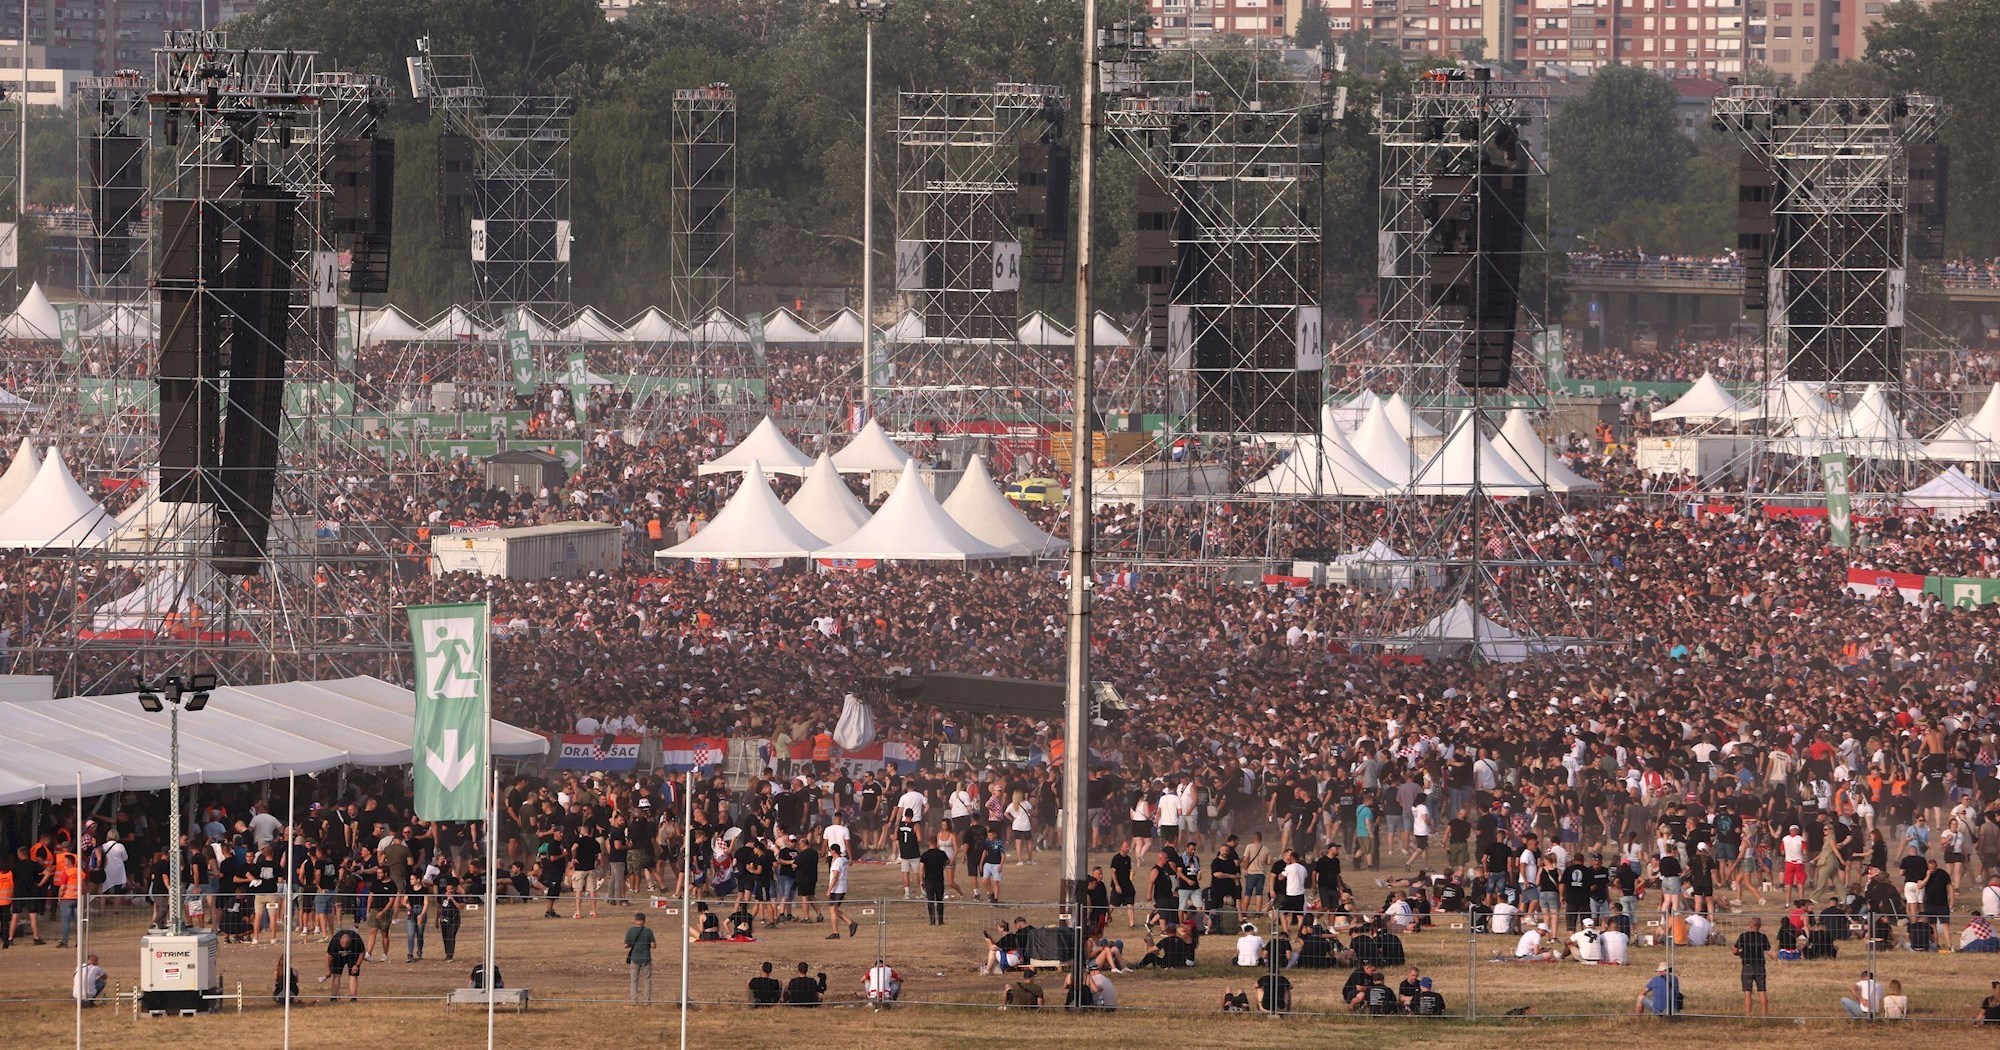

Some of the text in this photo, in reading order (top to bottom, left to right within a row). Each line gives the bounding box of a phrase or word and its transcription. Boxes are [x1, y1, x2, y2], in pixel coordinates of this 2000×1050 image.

[432, 426, 455, 434] EXIT
[465, 425, 488, 434] EXIT
[564, 744, 636, 757] ORA ŠAC
